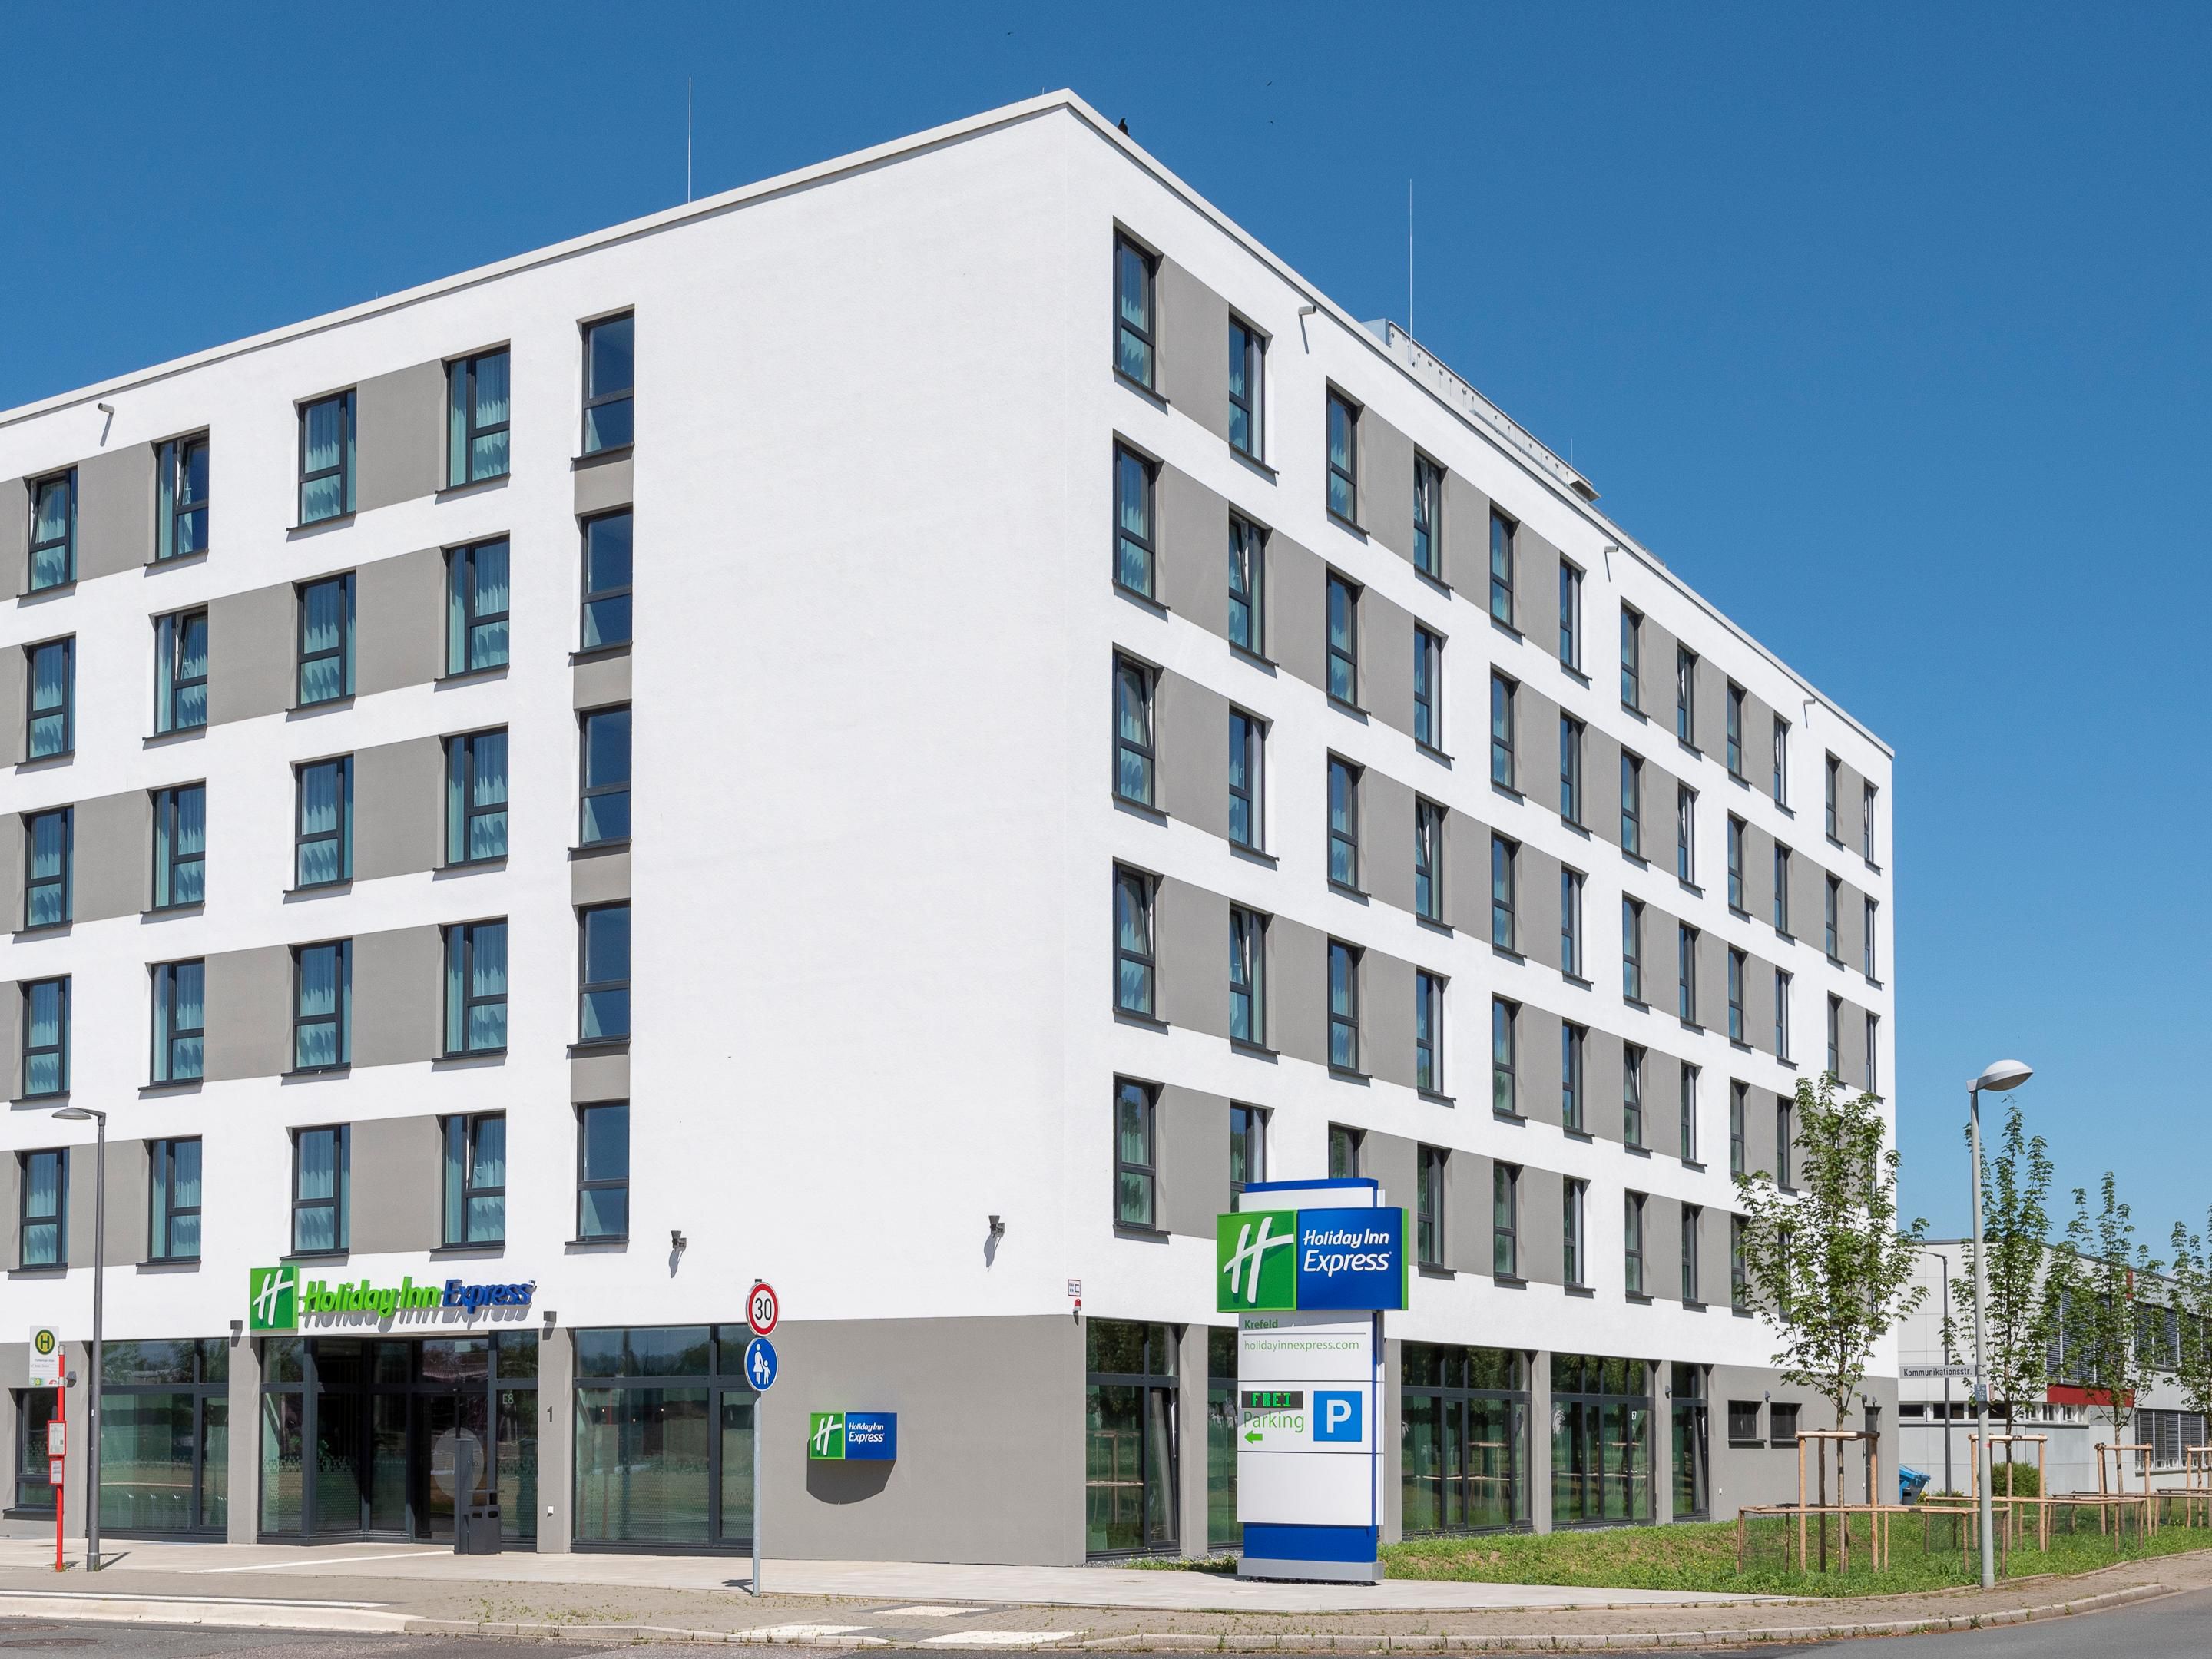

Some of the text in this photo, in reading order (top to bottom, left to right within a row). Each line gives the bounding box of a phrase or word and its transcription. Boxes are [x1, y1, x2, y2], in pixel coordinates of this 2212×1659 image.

[1303, 1228, 1389, 1249] Holiday Inn
[1303, 1250, 1389, 1277] Express
[304, 1276, 534, 1318] Holiday Inn Express
[754, 1297, 772, 1320] 30
[1244, 1319, 1279, 1329] Krefeld
[40, 1335, 50, 1349] H
[1244, 1339, 1359, 1352] holidayinnexpress.com
[1903, 1367, 1972, 1377] Kommunikationsstr.
[1252, 1392, 1291, 1407] FREI
[547, 1406, 553, 1422] 1
[1326, 1399, 1352, 1434] P
[848, 1422, 884, 1432] Holiday Inn
[1243, 1411, 1304, 1433] Parking
[848, 1431, 884, 1444] Express
